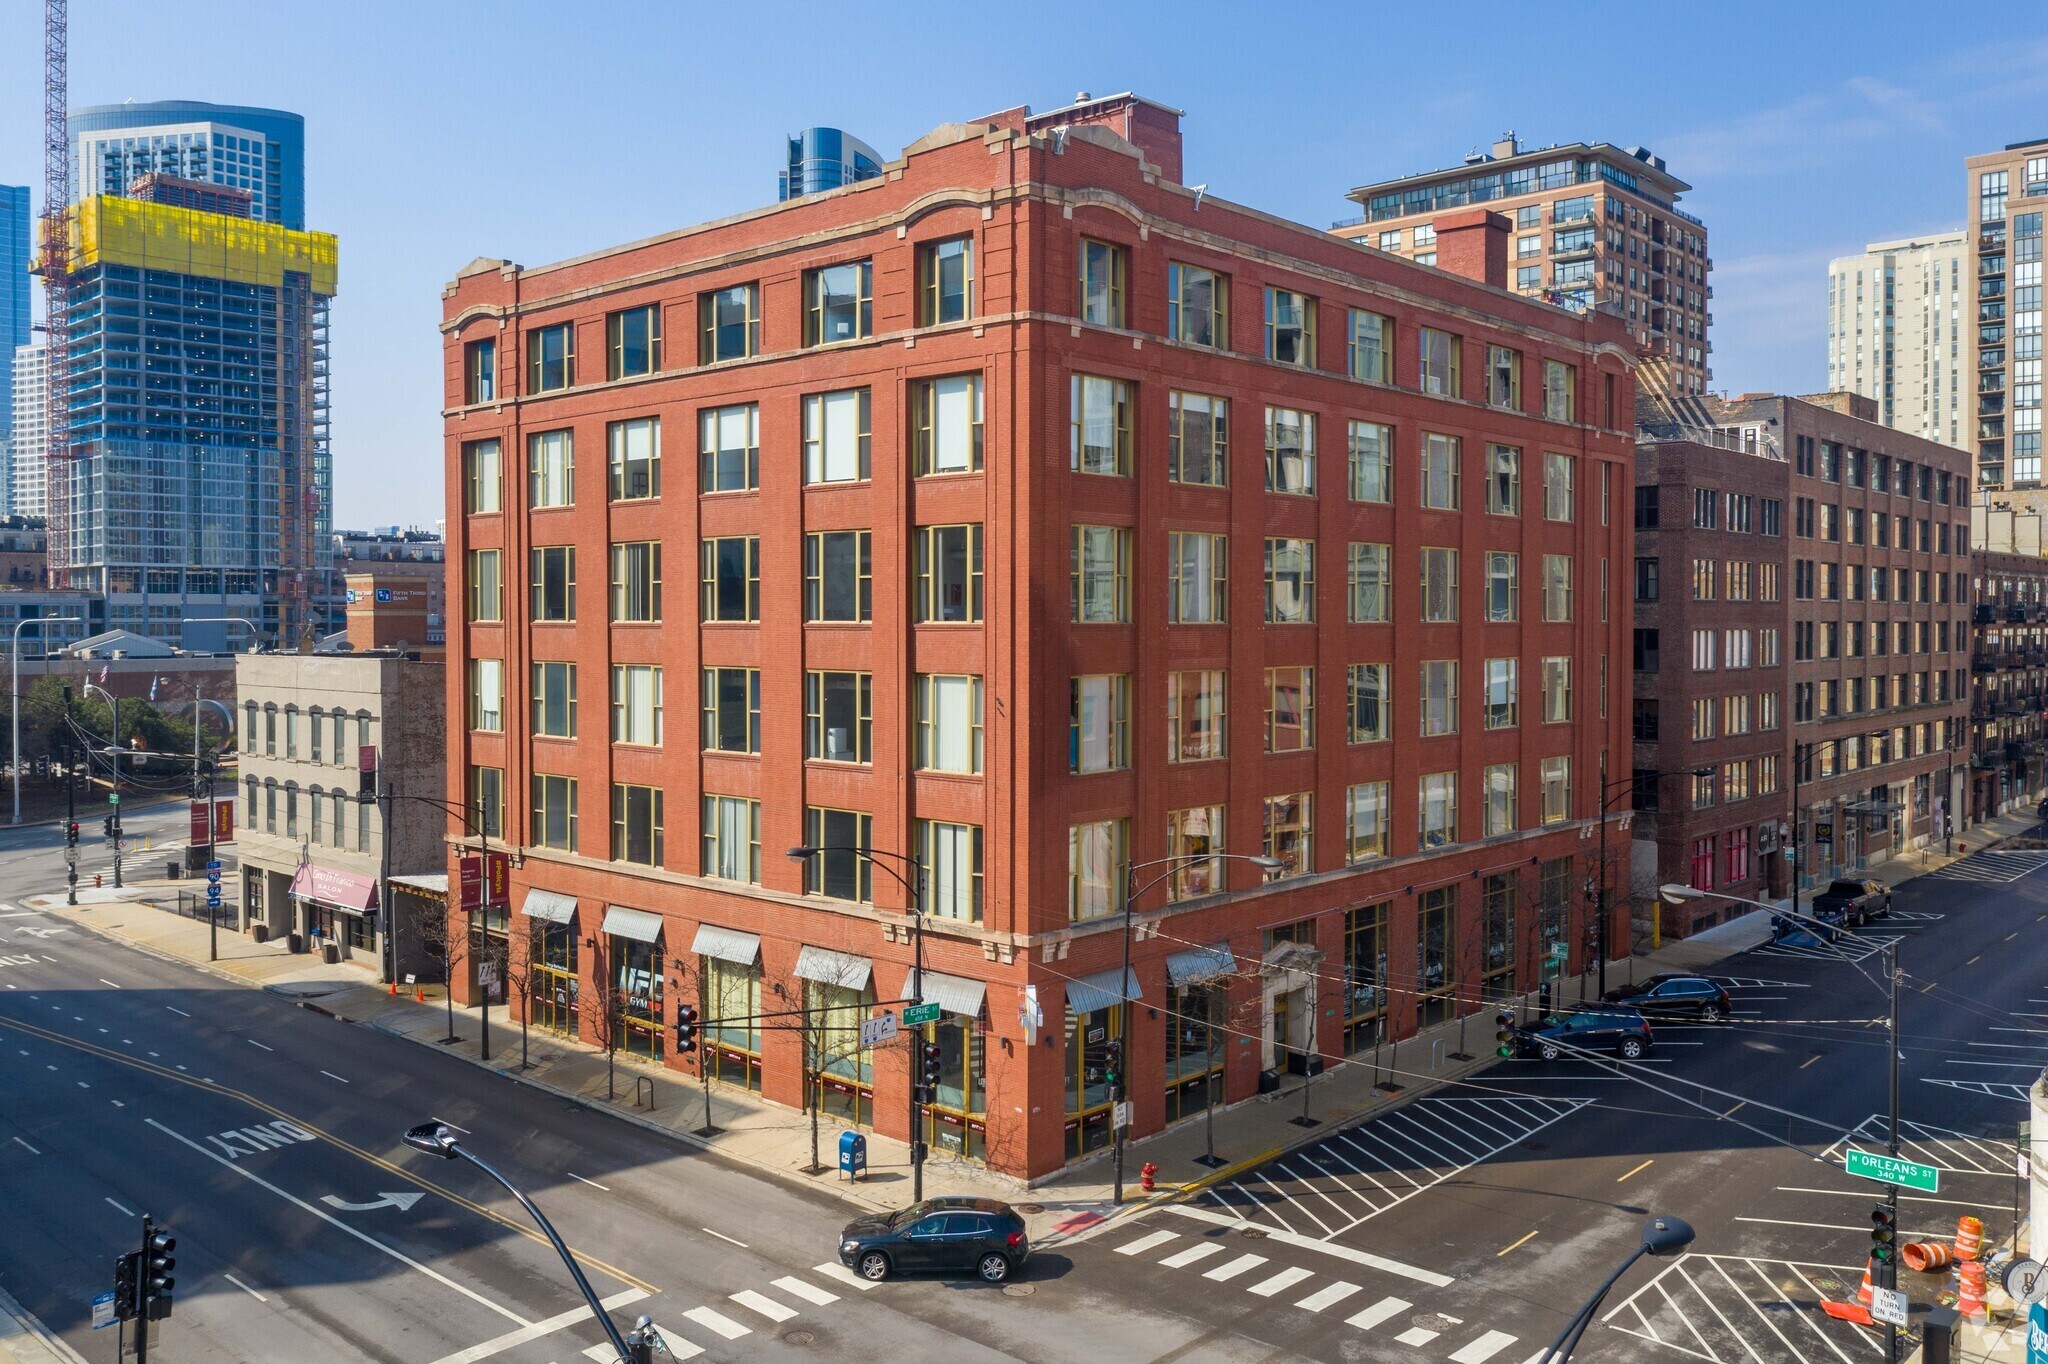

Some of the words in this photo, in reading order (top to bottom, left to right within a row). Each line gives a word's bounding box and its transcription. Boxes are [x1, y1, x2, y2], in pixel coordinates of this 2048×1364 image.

[210, 887, 219, 895] 94
[317, 883, 343, 894] SALON
[0, 954, 40, 968] NLY
[630, 996, 648, 1009] GYM
[910, 1006, 930, 1016] ERIE
[206, 1121, 317, 1159] ONLY
[1861, 1155, 1918, 1177] ORLEANS
[1922, 1170, 1932, 1178] ST
[1877, 1170, 1895, 1180] 340
[1898, 1174, 1906, 1182] W
[1883, 1291, 1897, 1301] NO
[1880, 1299, 1900, 1311] TURN
[1875, 1306, 1885, 1316] ON
[1889, 1311, 1904, 1321] RED
